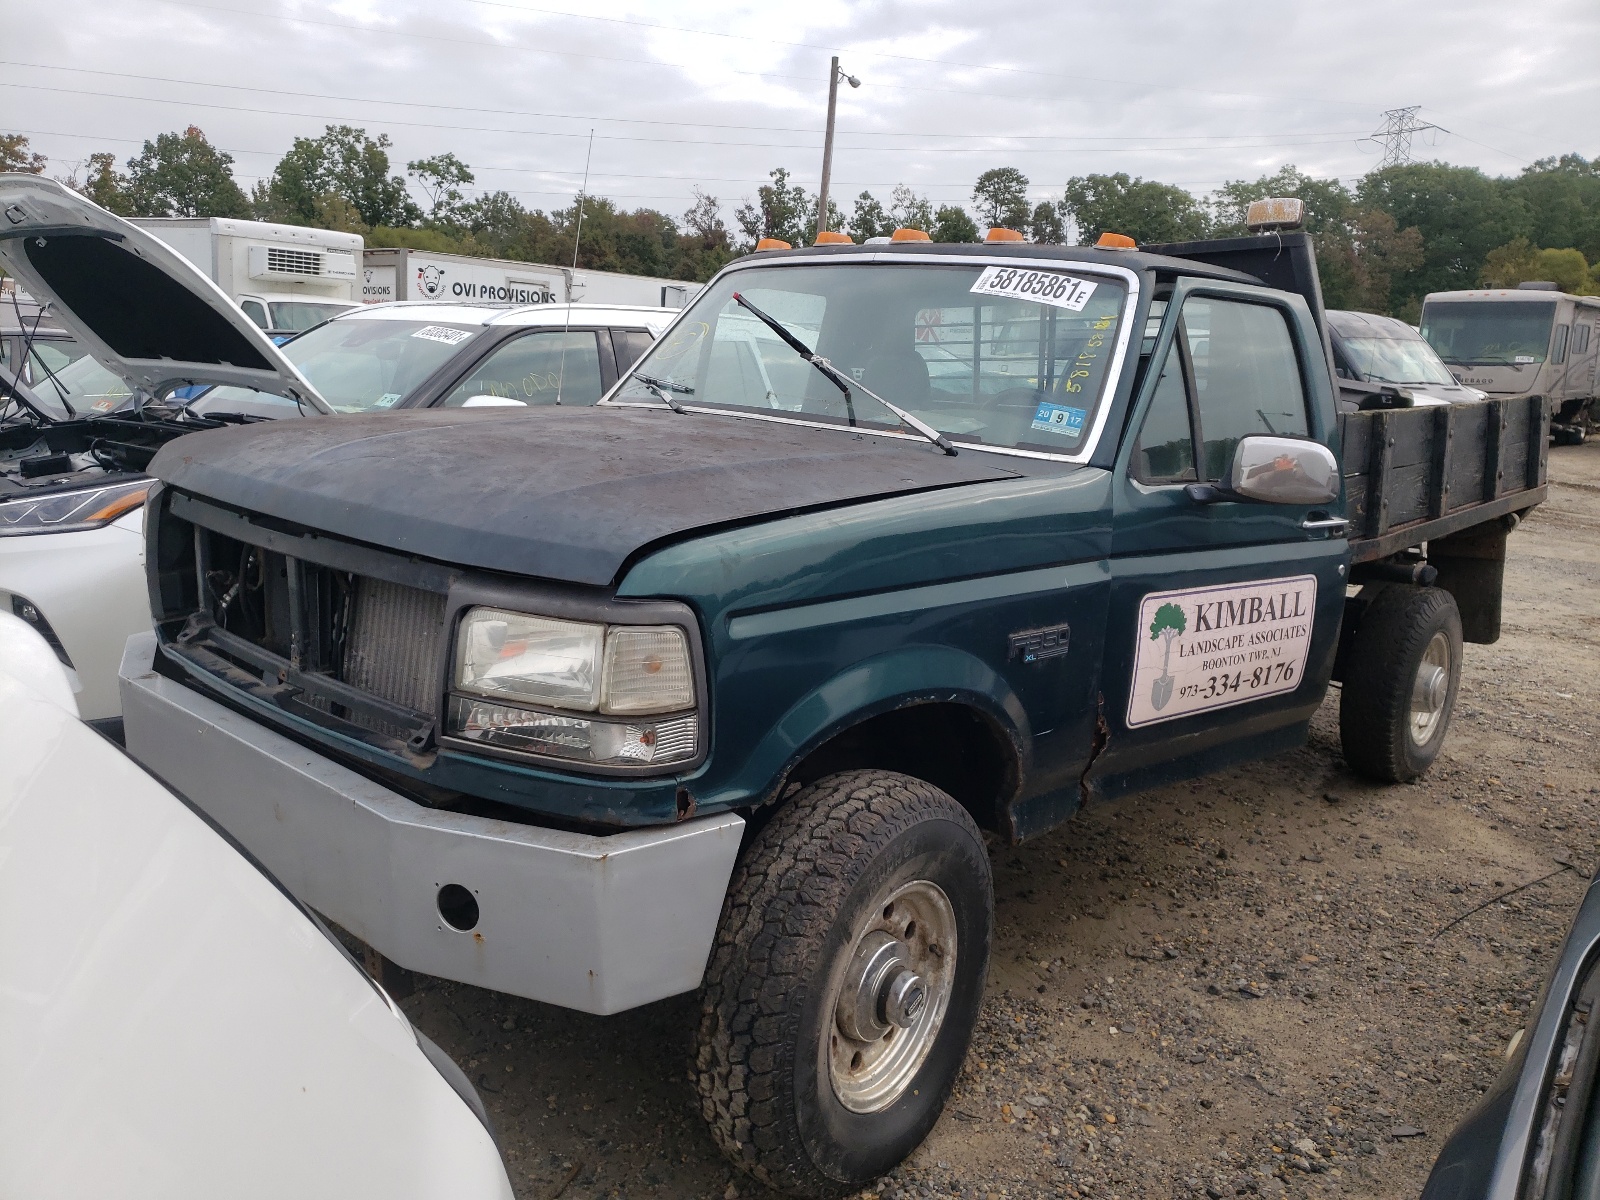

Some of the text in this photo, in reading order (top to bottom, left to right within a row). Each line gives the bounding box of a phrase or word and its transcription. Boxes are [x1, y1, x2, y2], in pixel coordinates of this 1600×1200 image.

[362, 286, 391, 295] OVISIONS
[452, 281, 556, 304] OVI PROVISIONS
[1038, 409, 1082, 425] 20 9 17
[1194, 591, 1306, 633] KIMBALL
[1179, 624, 1307, 658] LANDSCAPE ASSOCIATES
[1024, 653, 1037, 662] XL
[1201, 652, 1247, 672] BOONTON
[1270, 646, 1282, 659] NJ
[1179, 659, 1297, 700] 973-334-8176
